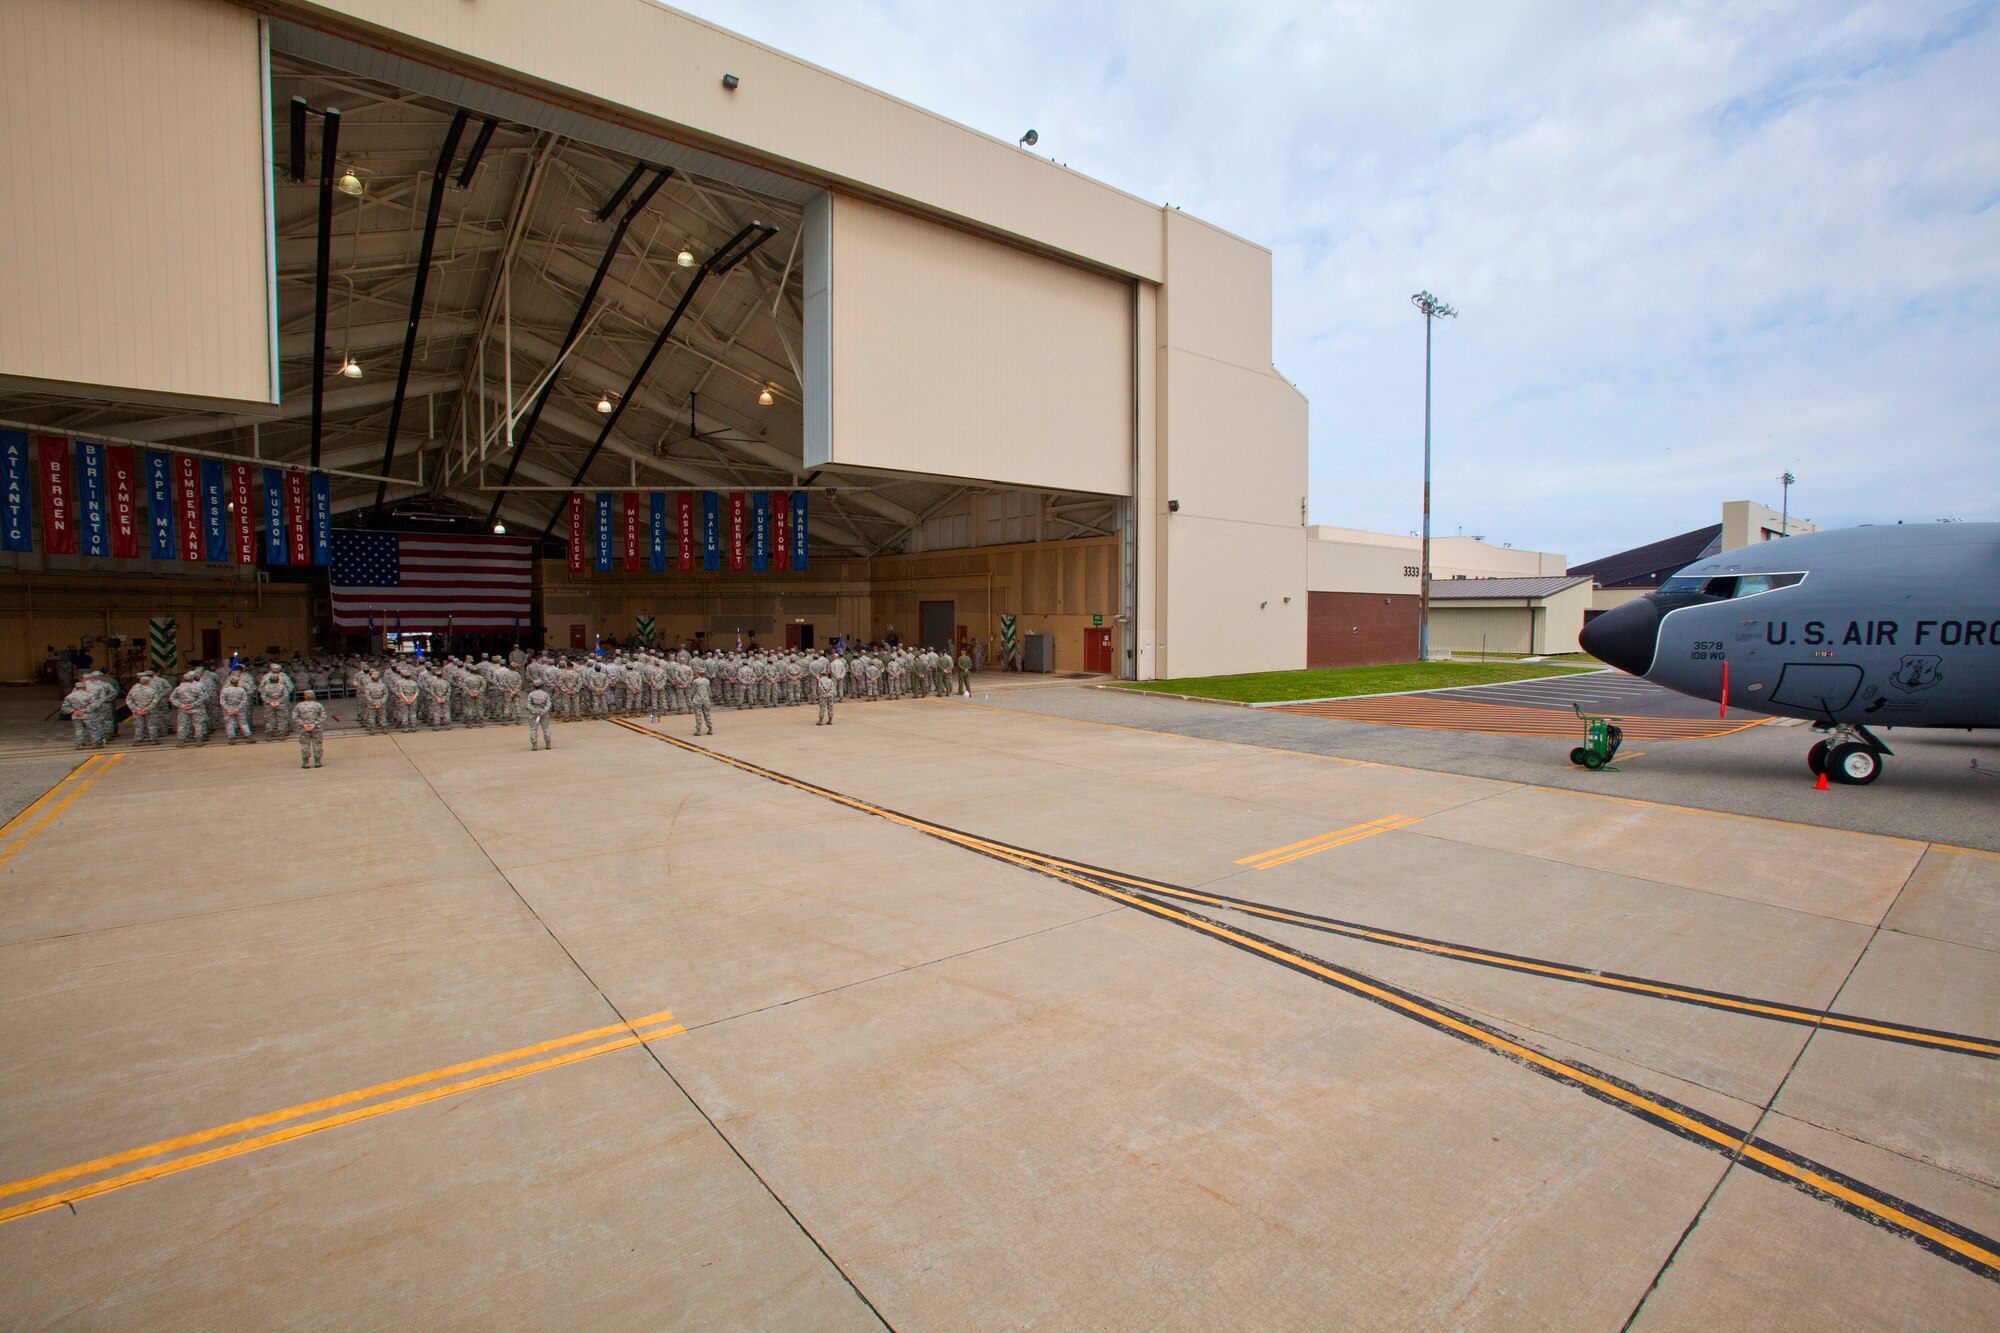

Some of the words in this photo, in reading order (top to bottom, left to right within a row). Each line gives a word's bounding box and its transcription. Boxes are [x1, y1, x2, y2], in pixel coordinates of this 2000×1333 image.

[7, 445, 21, 539] ATLANTIC
[50, 462, 65, 530] BERGEN
[86, 445, 100, 555] BURLINGTON
[117, 470, 131, 535] CAMDEN
[154, 459, 164, 500] CAPE
[156, 518, 167, 548] MAY
[184, 458, 198, 560] CUMBERLAND
[209, 486, 219, 536] ESSEX
[238, 467, 251, 562] GLOUCESTER
[270, 489, 280, 546] HUDSON
[292, 477, 305, 560] HUNTERDON
[317, 494, 327, 548] MERCER
[573, 498, 581, 569] MIDDLESEX
[600, 501, 608, 564] MONMOUTH
[627, 509, 635, 556] MORRIS
[682, 505, 690, 558] PASSAIC
[734, 500, 742, 563] SOMERSET
[796, 509, 804, 555] WARREN
[1404, 566, 1420, 578] 3333
[1690, 652, 1707, 660] 108
[1709, 652, 1725, 660] WG
[1693, 642, 1723, 650] 3578
[1766, 621, 1834, 646] U.S.
[1842, 621, 1898, 646] AIR
